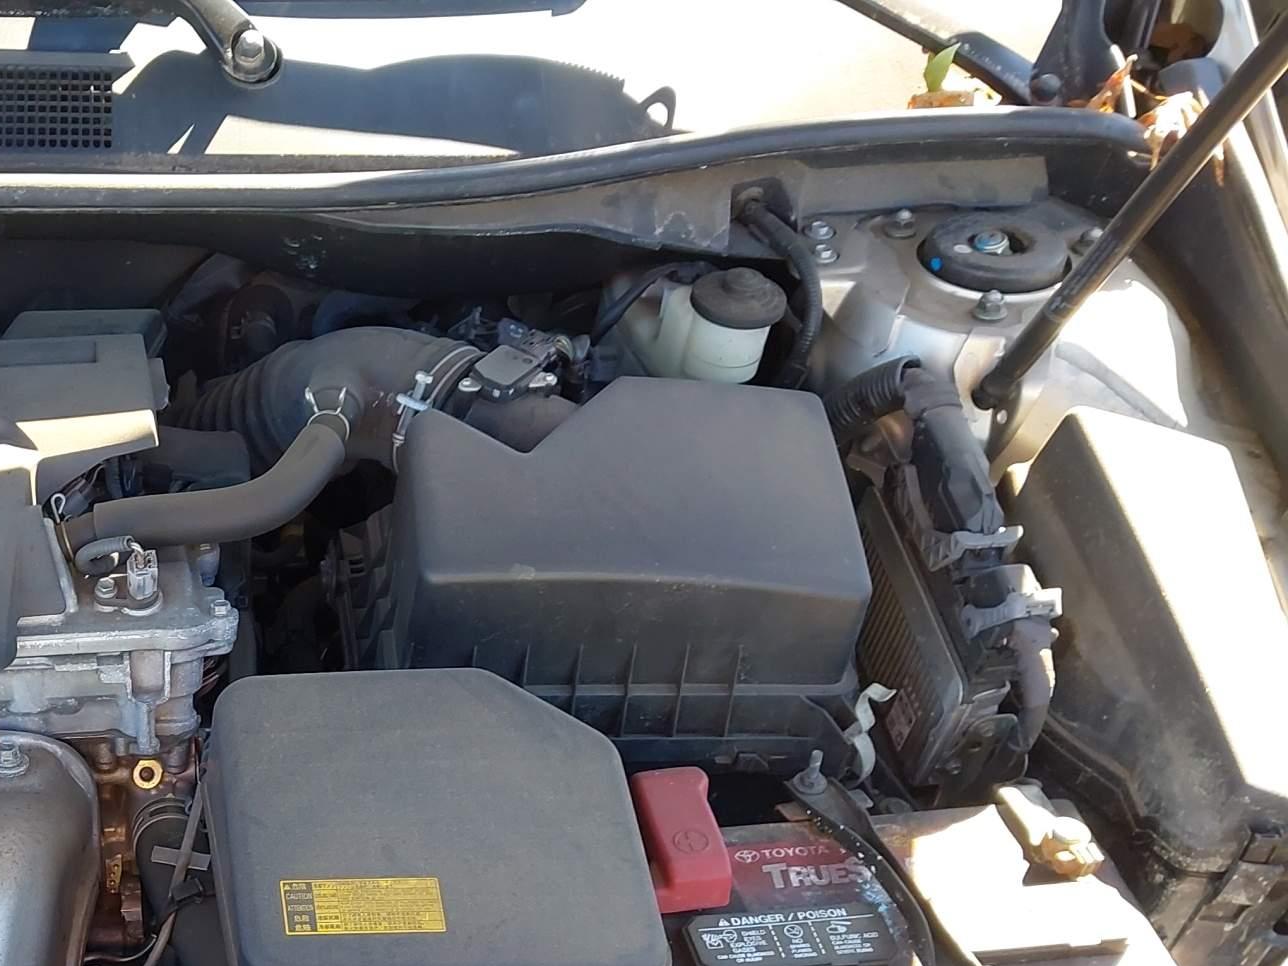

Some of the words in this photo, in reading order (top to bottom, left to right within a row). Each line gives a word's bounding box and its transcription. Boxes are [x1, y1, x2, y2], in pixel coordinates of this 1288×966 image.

[761, 846, 829, 859] TOYOTA
[762, 856, 873, 889] TRUES
[286, 892, 313, 900] CAUTION
[730, 912, 785, 926] DANGER
[787, 912, 795, 921] /
[798, 907, 847, 921] POISON
